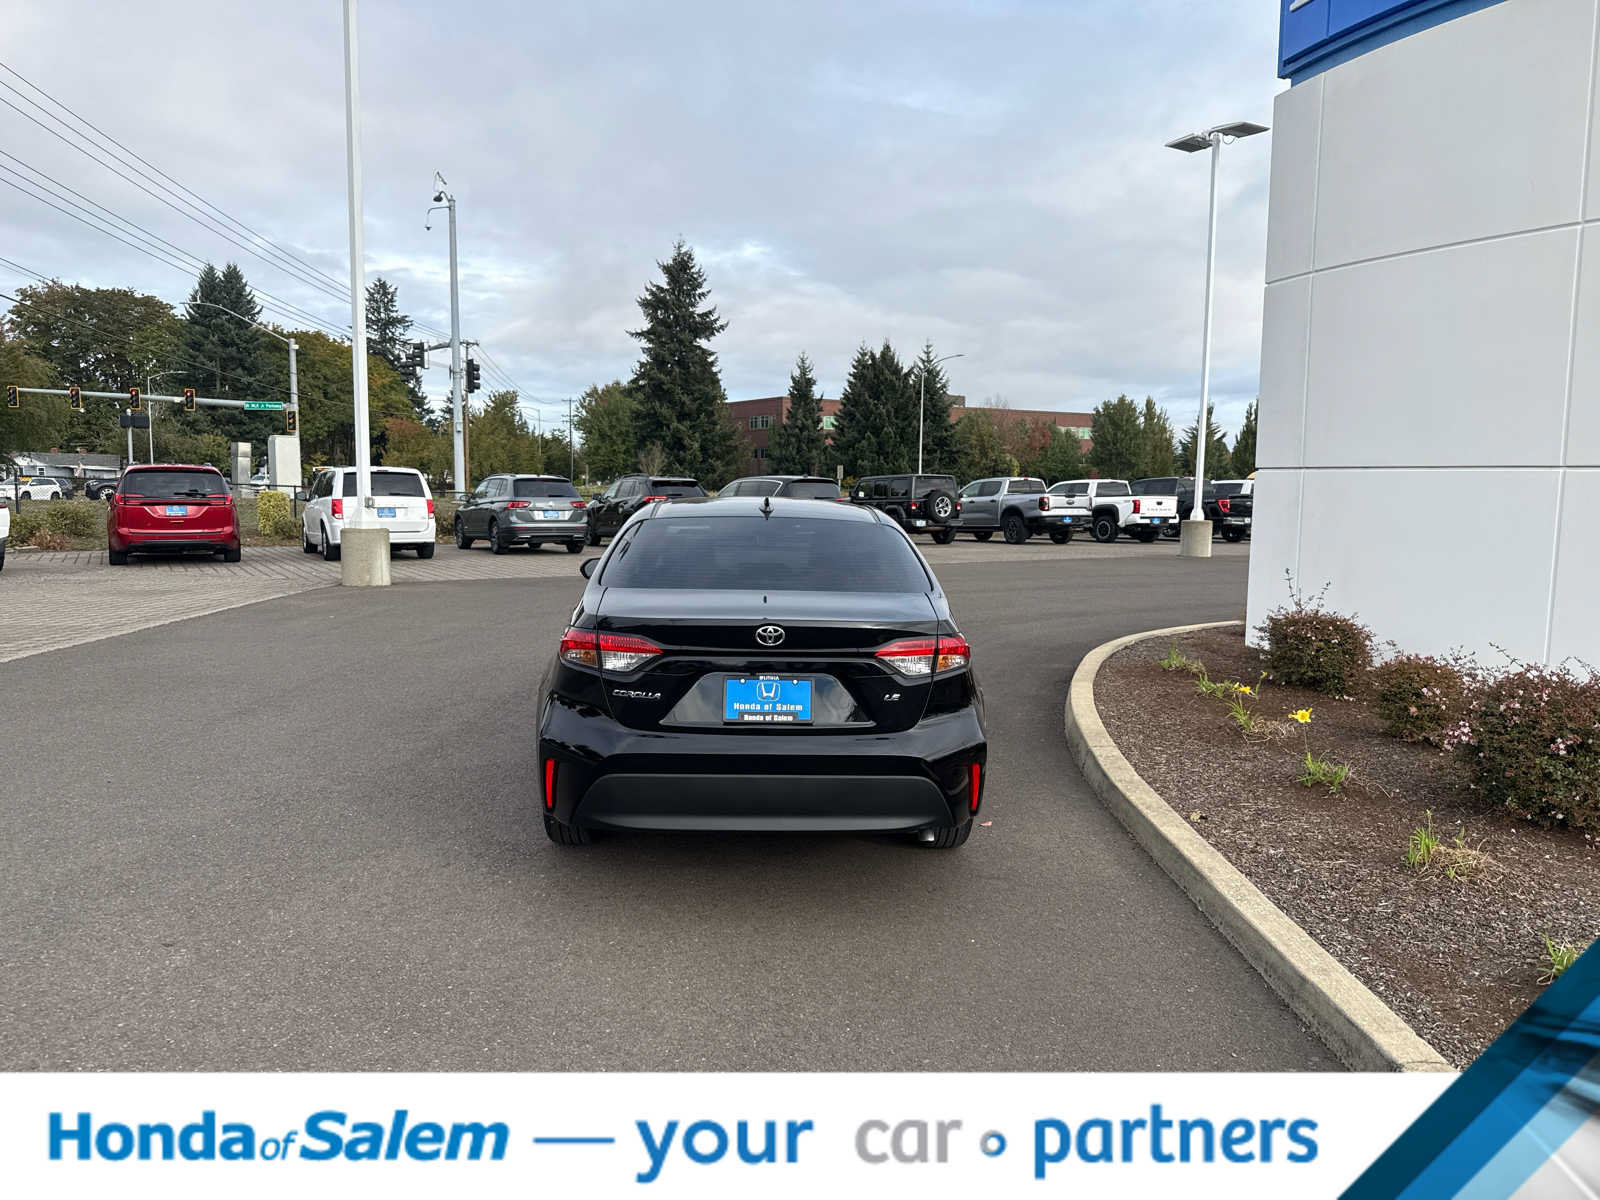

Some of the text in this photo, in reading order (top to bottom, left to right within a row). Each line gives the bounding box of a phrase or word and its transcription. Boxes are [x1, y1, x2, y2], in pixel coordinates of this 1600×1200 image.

[612, 689, 661, 699] COROLLA
[733, 702, 803, 712] Honda of Salem
